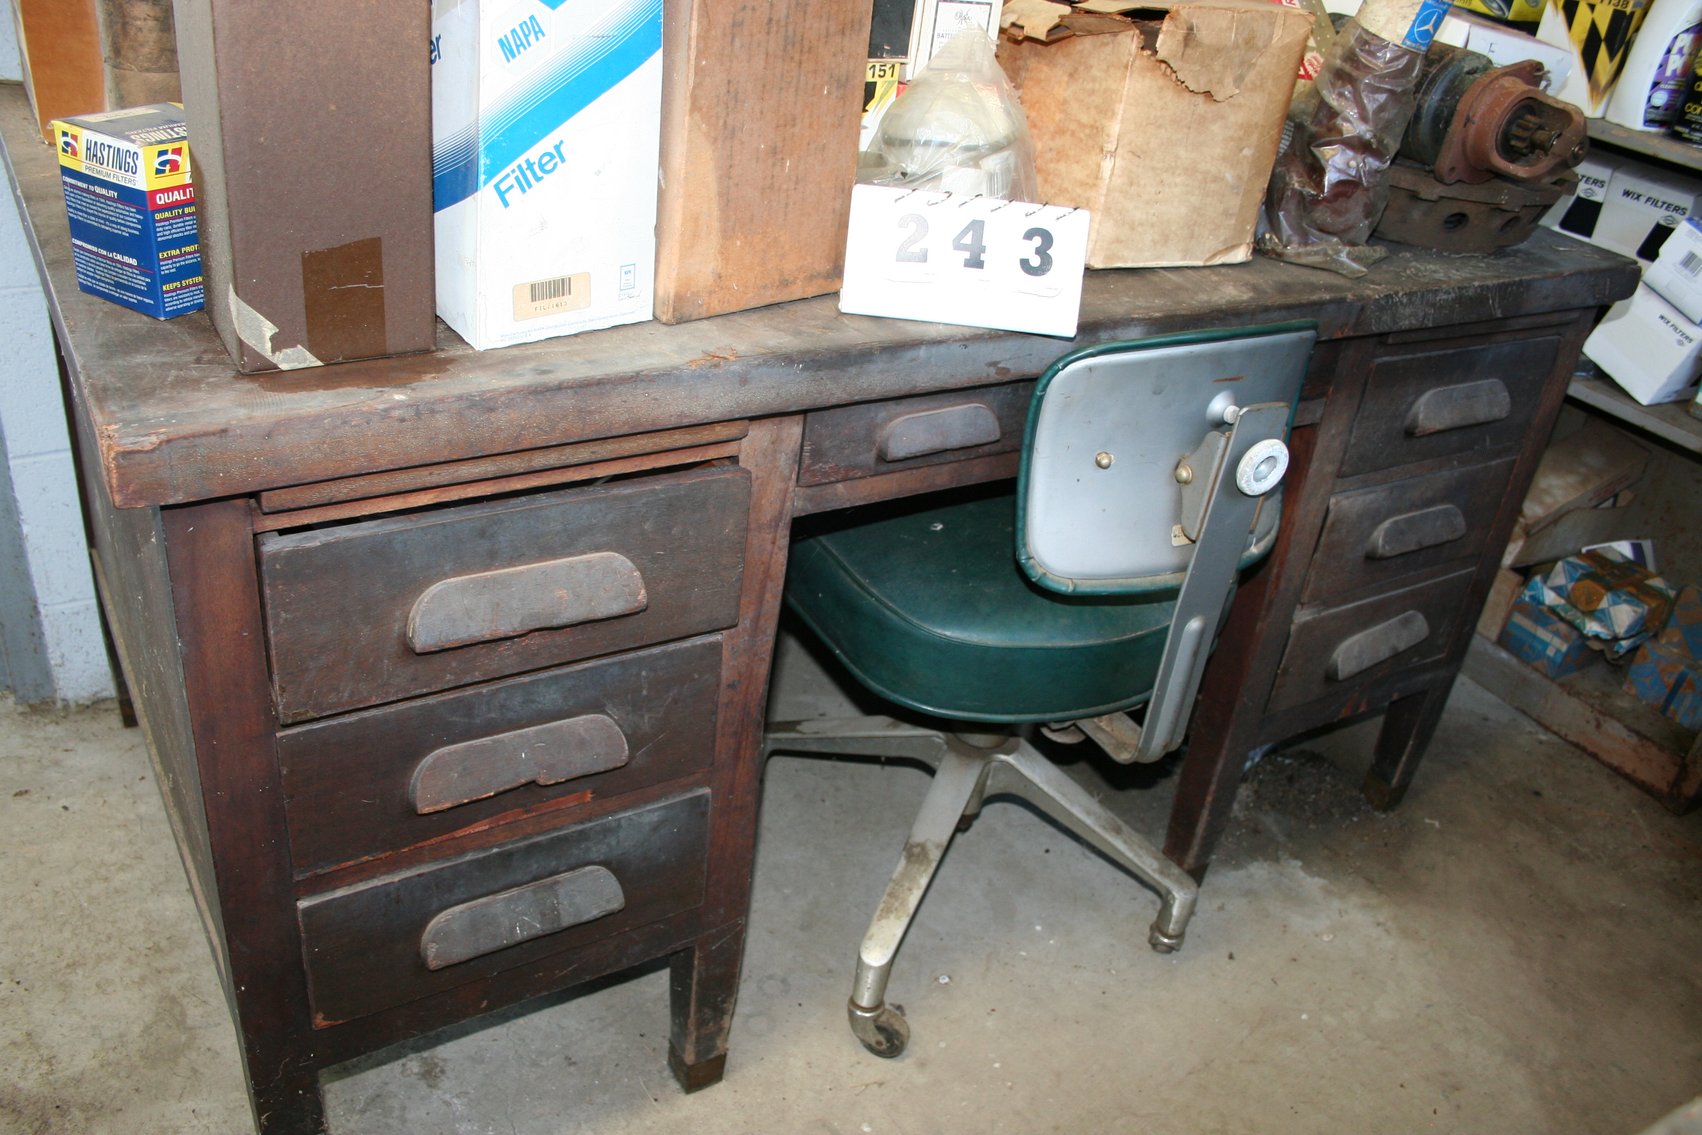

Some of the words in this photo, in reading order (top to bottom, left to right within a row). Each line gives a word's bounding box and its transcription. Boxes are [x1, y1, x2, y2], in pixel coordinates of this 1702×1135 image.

[497, 14, 546, 63] NAPA
[868, 64, 896, 78] 151
[85, 138, 139, 176] HASTINGS
[84, 165, 112, 180] PREMIUM
[112, 172, 137, 187] FILTERS
[493, 139, 567, 209] Filter
[94, 185, 118, 199] QUALITY
[1622, 188, 1643, 201] WIX
[1644, 196, 1688, 217] FILTERS
[154, 208, 183, 220] QUALITY
[159, 248, 180, 259] EXTRA
[895, 213, 1054, 277] 243
[112, 252, 138, 266] CALIDAD
[162, 281, 181, 291] KEEPS
[1658, 313, 1671, 326] WIX
[1669, 322, 1695, 344] FILTERS
